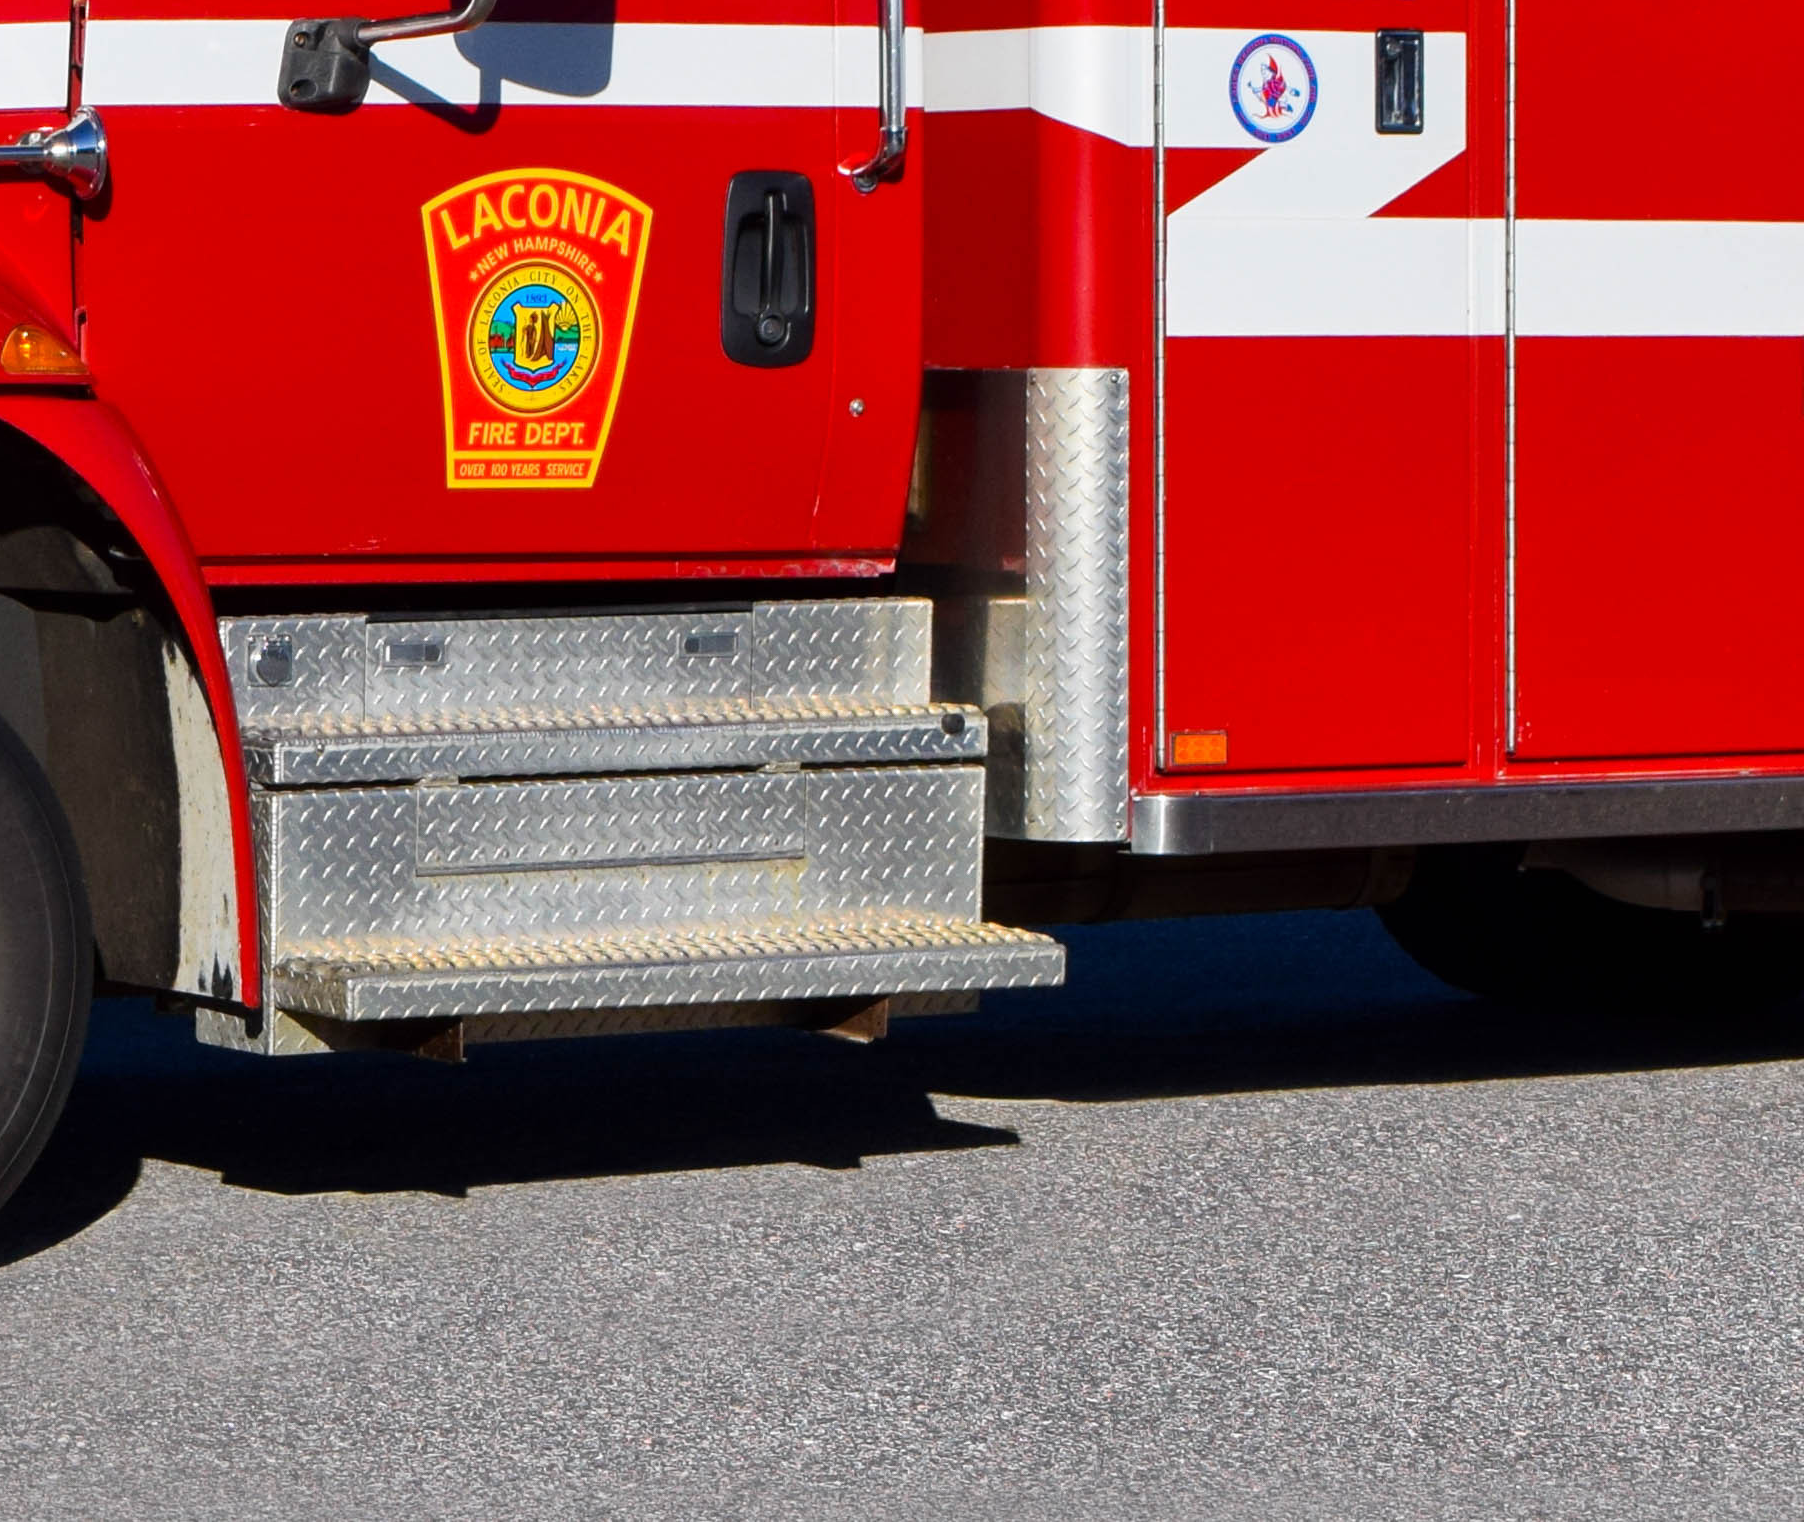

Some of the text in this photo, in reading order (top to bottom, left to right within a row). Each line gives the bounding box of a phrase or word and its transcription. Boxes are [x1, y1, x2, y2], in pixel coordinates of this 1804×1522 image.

[440, 184, 631, 256] LACONIA
[476, 236, 597, 277] NEW HAMPSHIRE
[480, 277, 520, 326] LACONIA
[529, 271, 558, 286] CITY
[566, 285, 581, 304] ON
[580, 313, 592, 341] THE
[477, 340, 488, 356] OF
[468, 422, 585, 445] FIRE DEPT.
[460, 462, 585, 477] OVER 100 YEARS SERVICE
